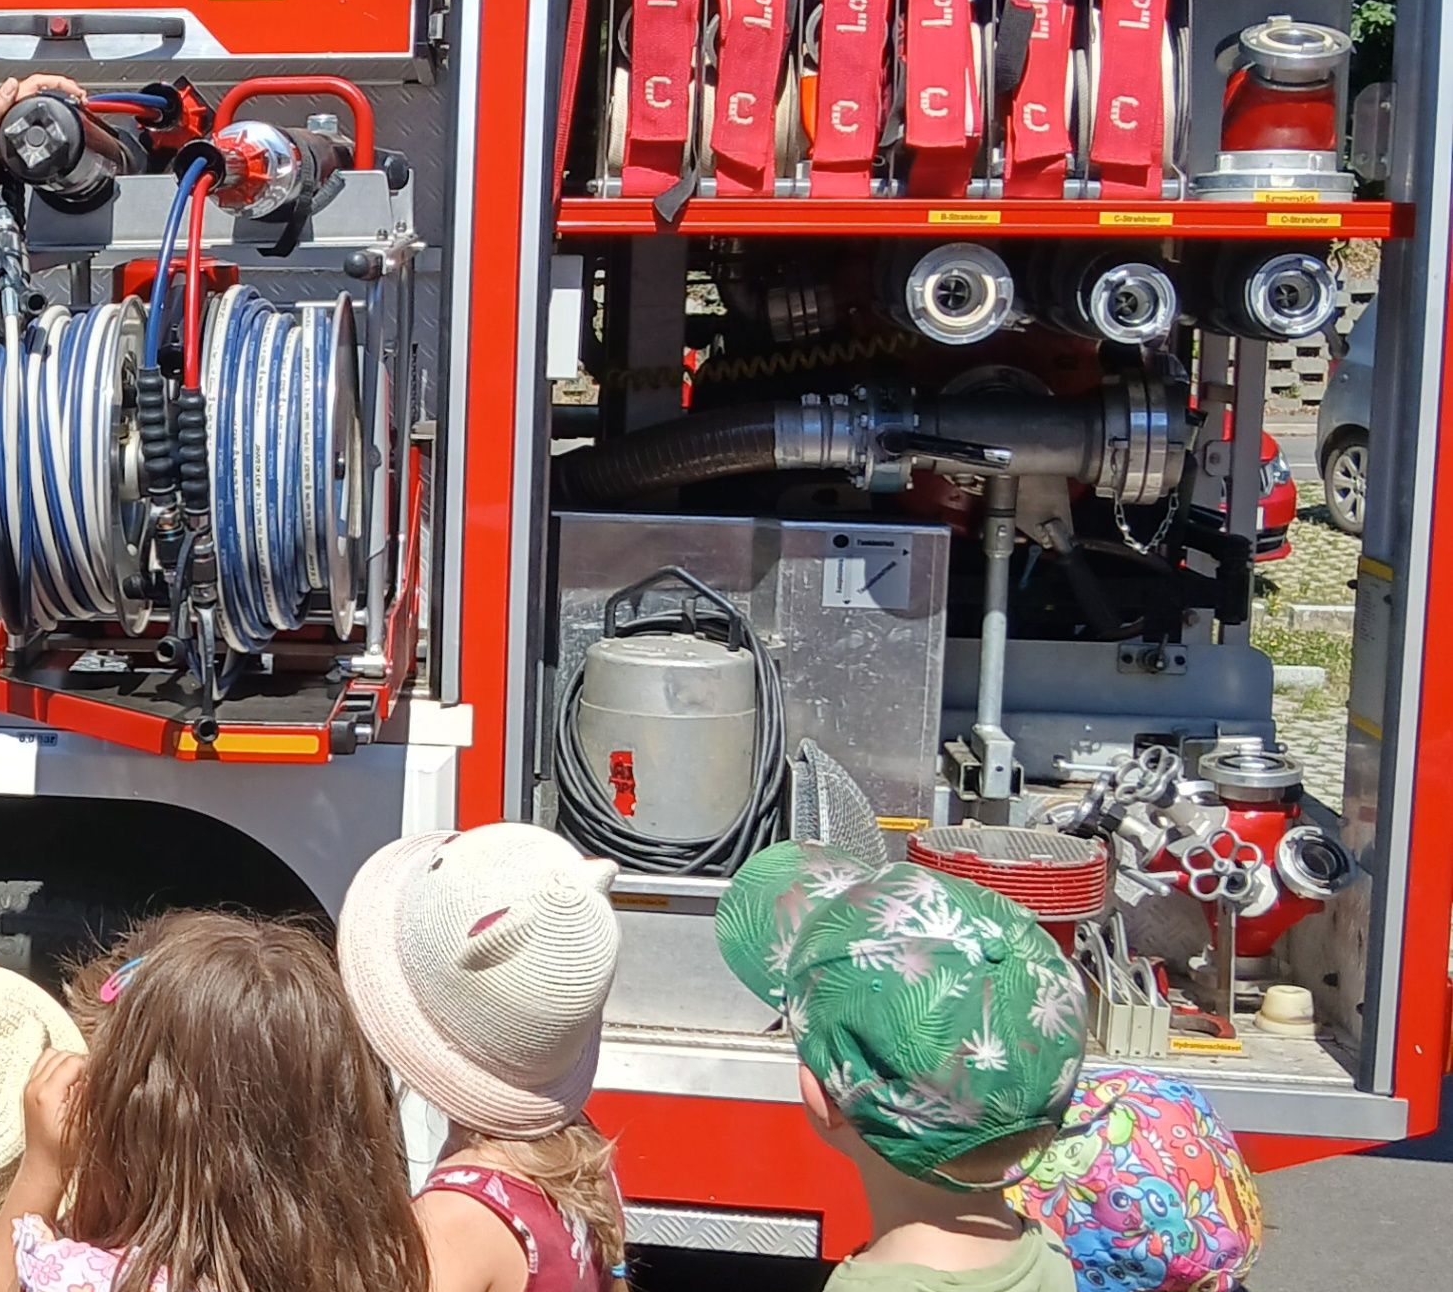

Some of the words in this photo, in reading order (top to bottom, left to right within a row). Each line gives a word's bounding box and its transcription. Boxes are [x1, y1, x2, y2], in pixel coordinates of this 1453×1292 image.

[645, 76, 671, 108] C
[728, 92, 756, 124] C
[920, 87, 949, 117] C
[831, 100, 859, 133] C
[1023, 103, 1050, 132] C
[1110, 96, 1139, 130] C
